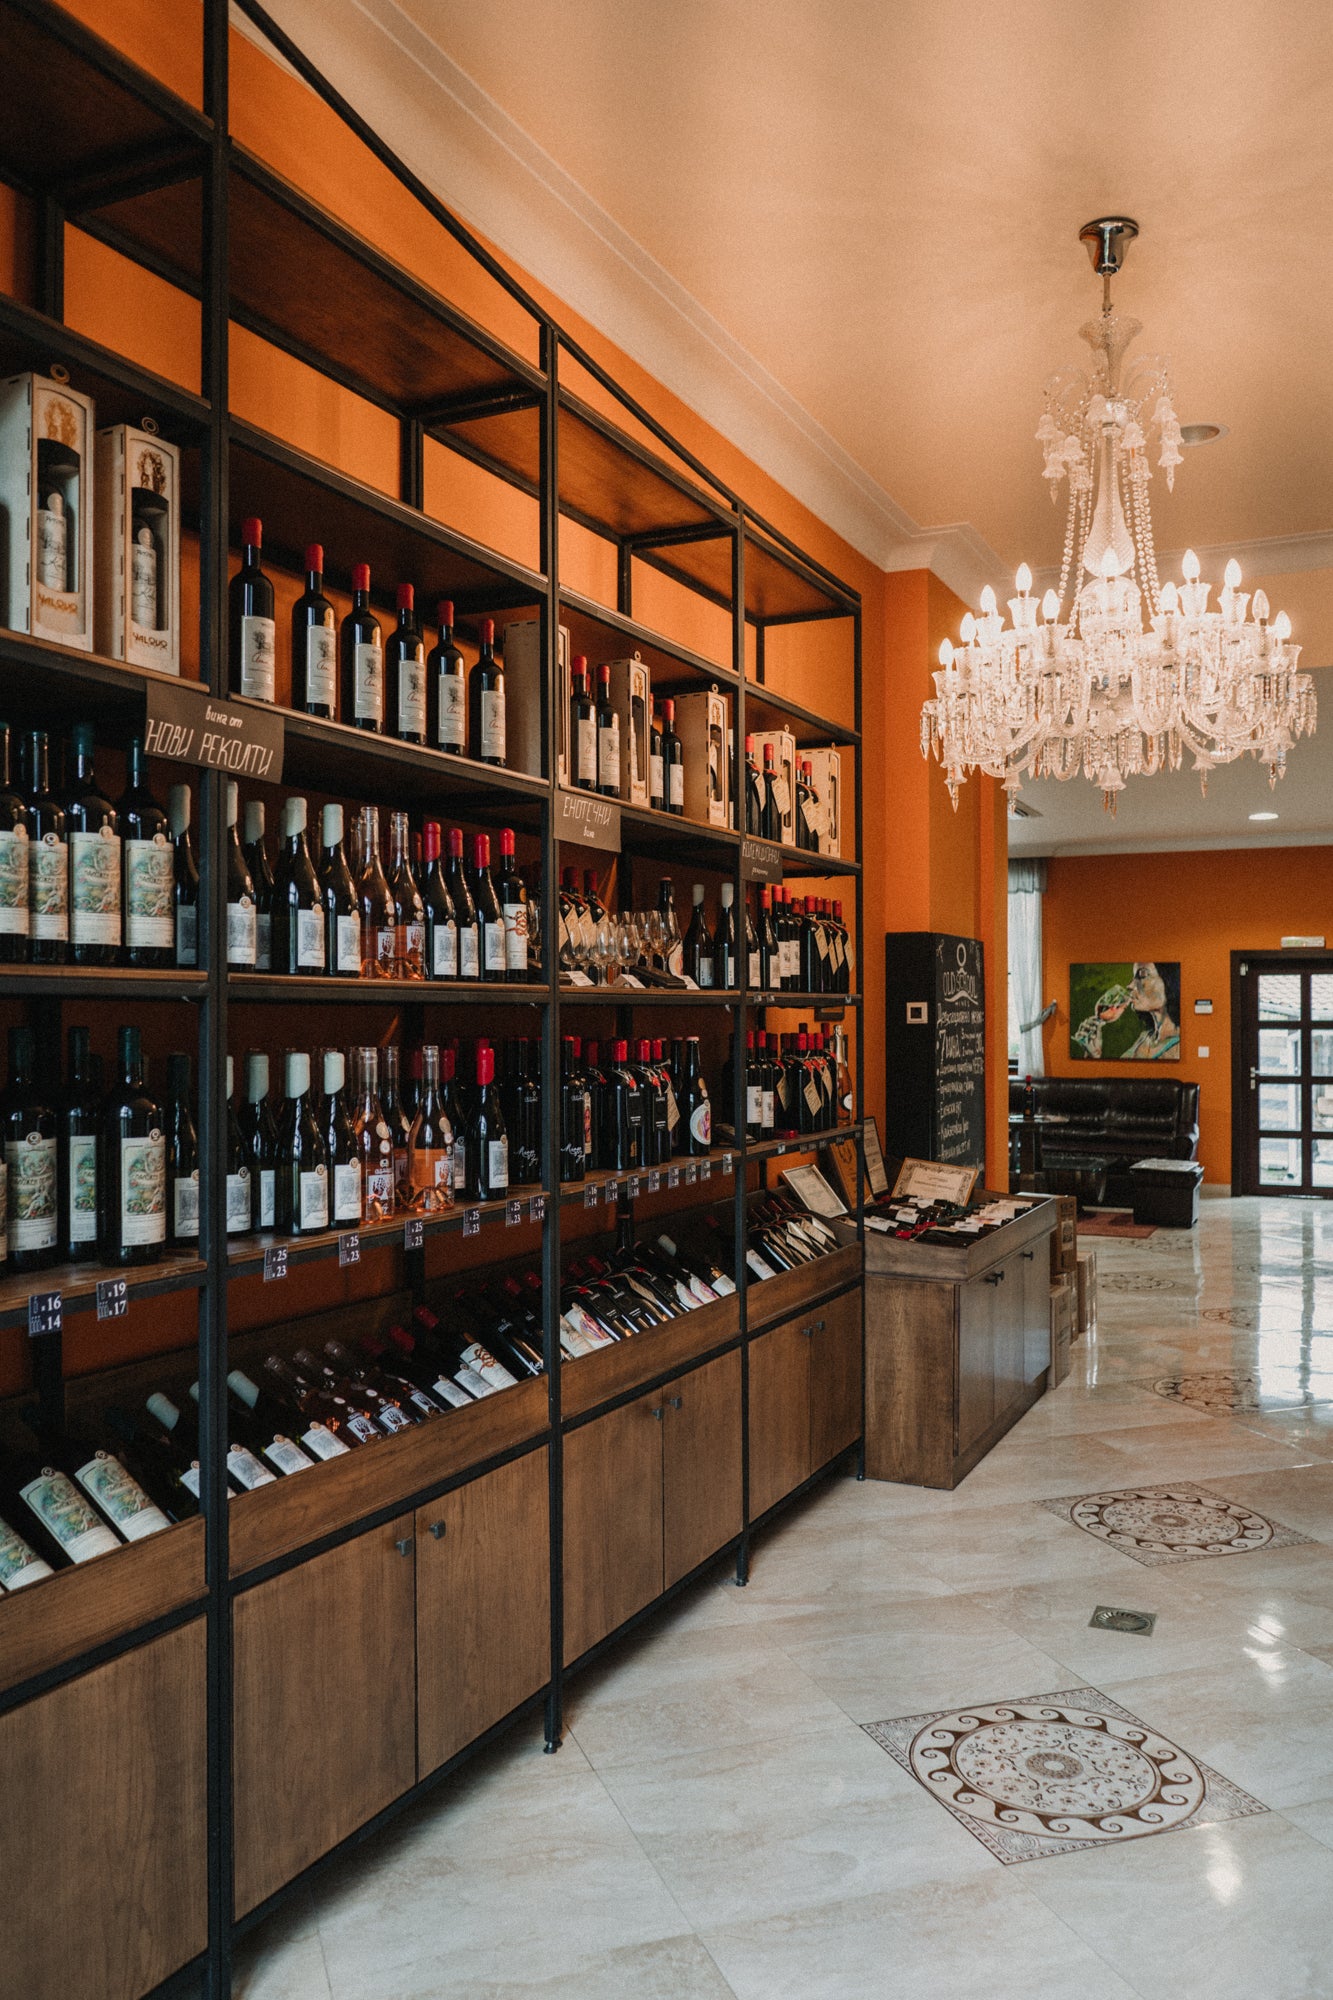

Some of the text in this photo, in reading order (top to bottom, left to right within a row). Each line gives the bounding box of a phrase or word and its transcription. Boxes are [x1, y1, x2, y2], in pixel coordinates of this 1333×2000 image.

[144, 719, 274, 775] НОВИ РЕКОЛТИ
[562, 796, 612, 826] ЕНОТЕЧНИ
